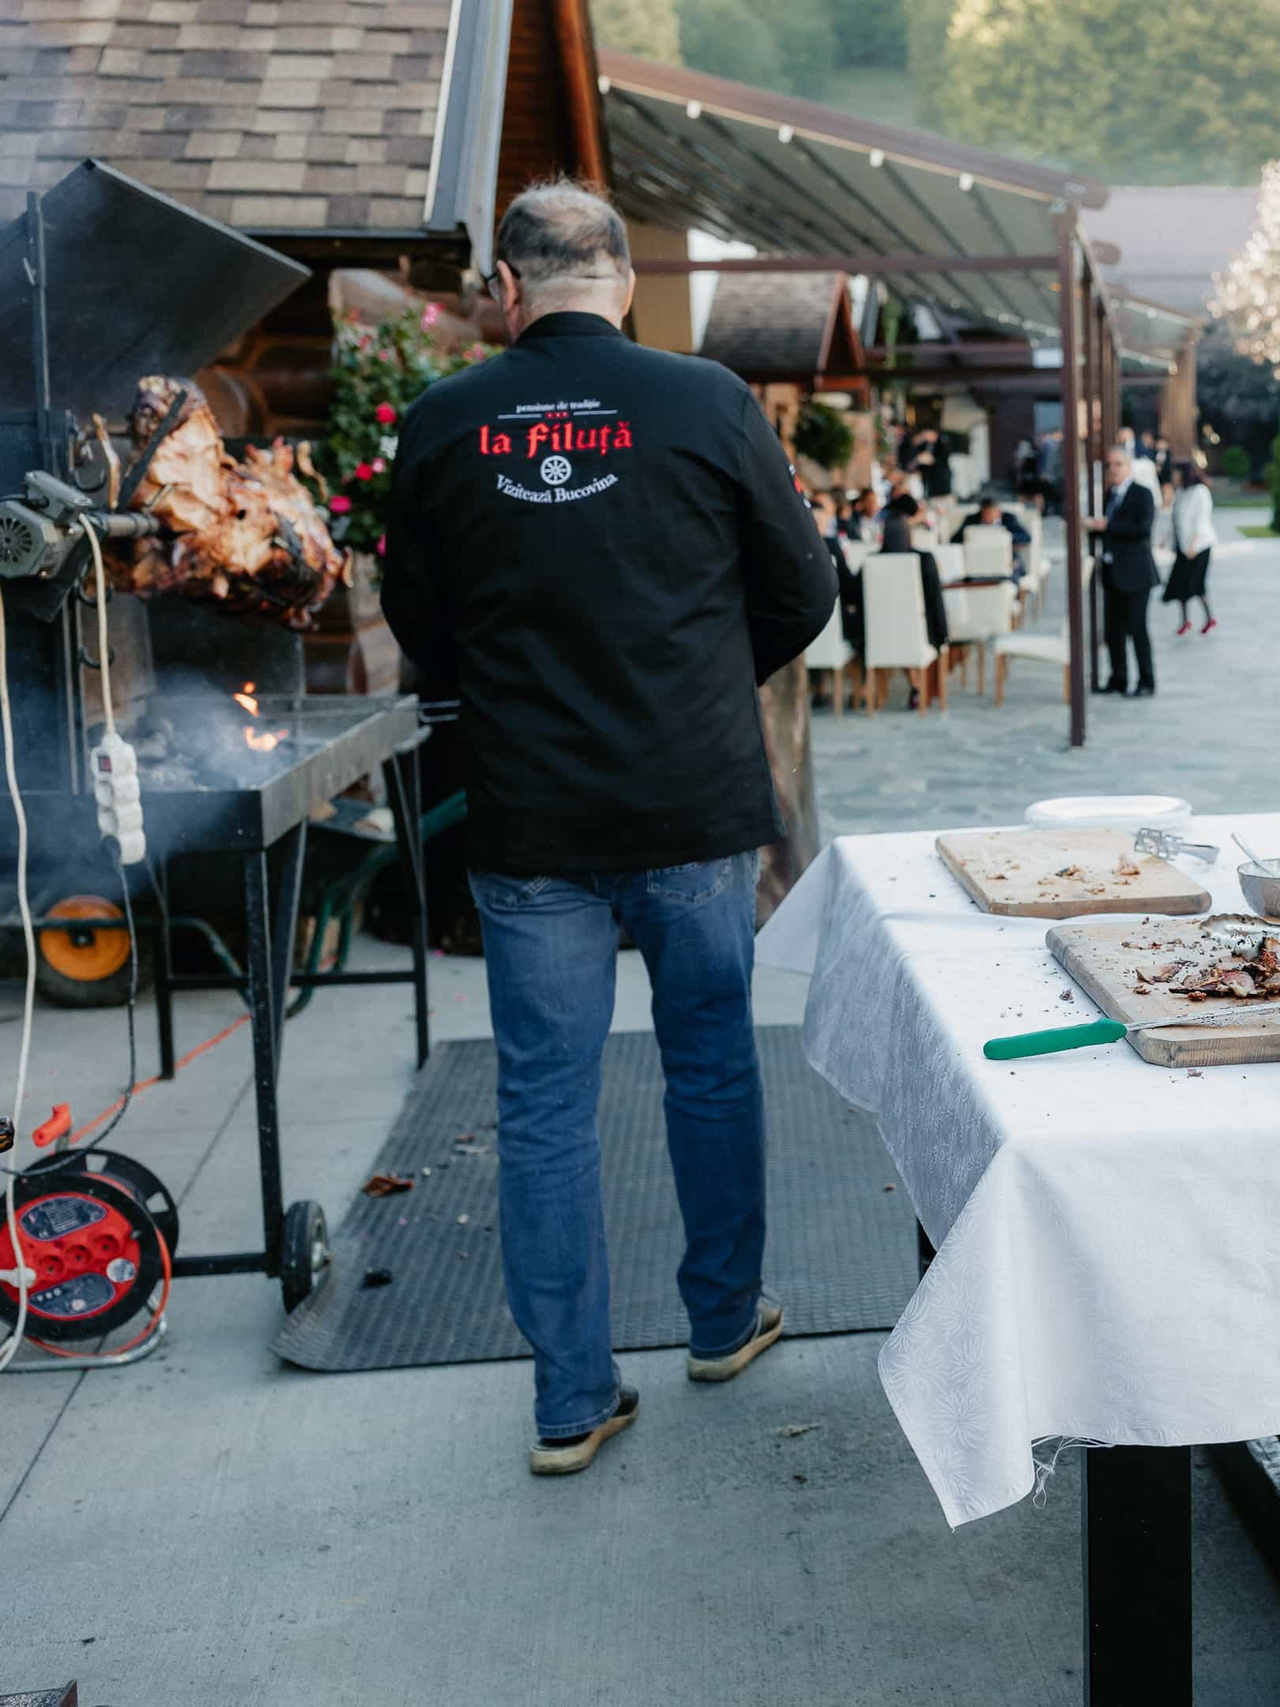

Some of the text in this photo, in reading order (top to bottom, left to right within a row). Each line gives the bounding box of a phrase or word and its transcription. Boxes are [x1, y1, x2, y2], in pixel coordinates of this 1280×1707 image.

[556, 401, 568, 410] de
[480, 424, 512, 455] la
[554, 473, 618, 502] Bucovina
